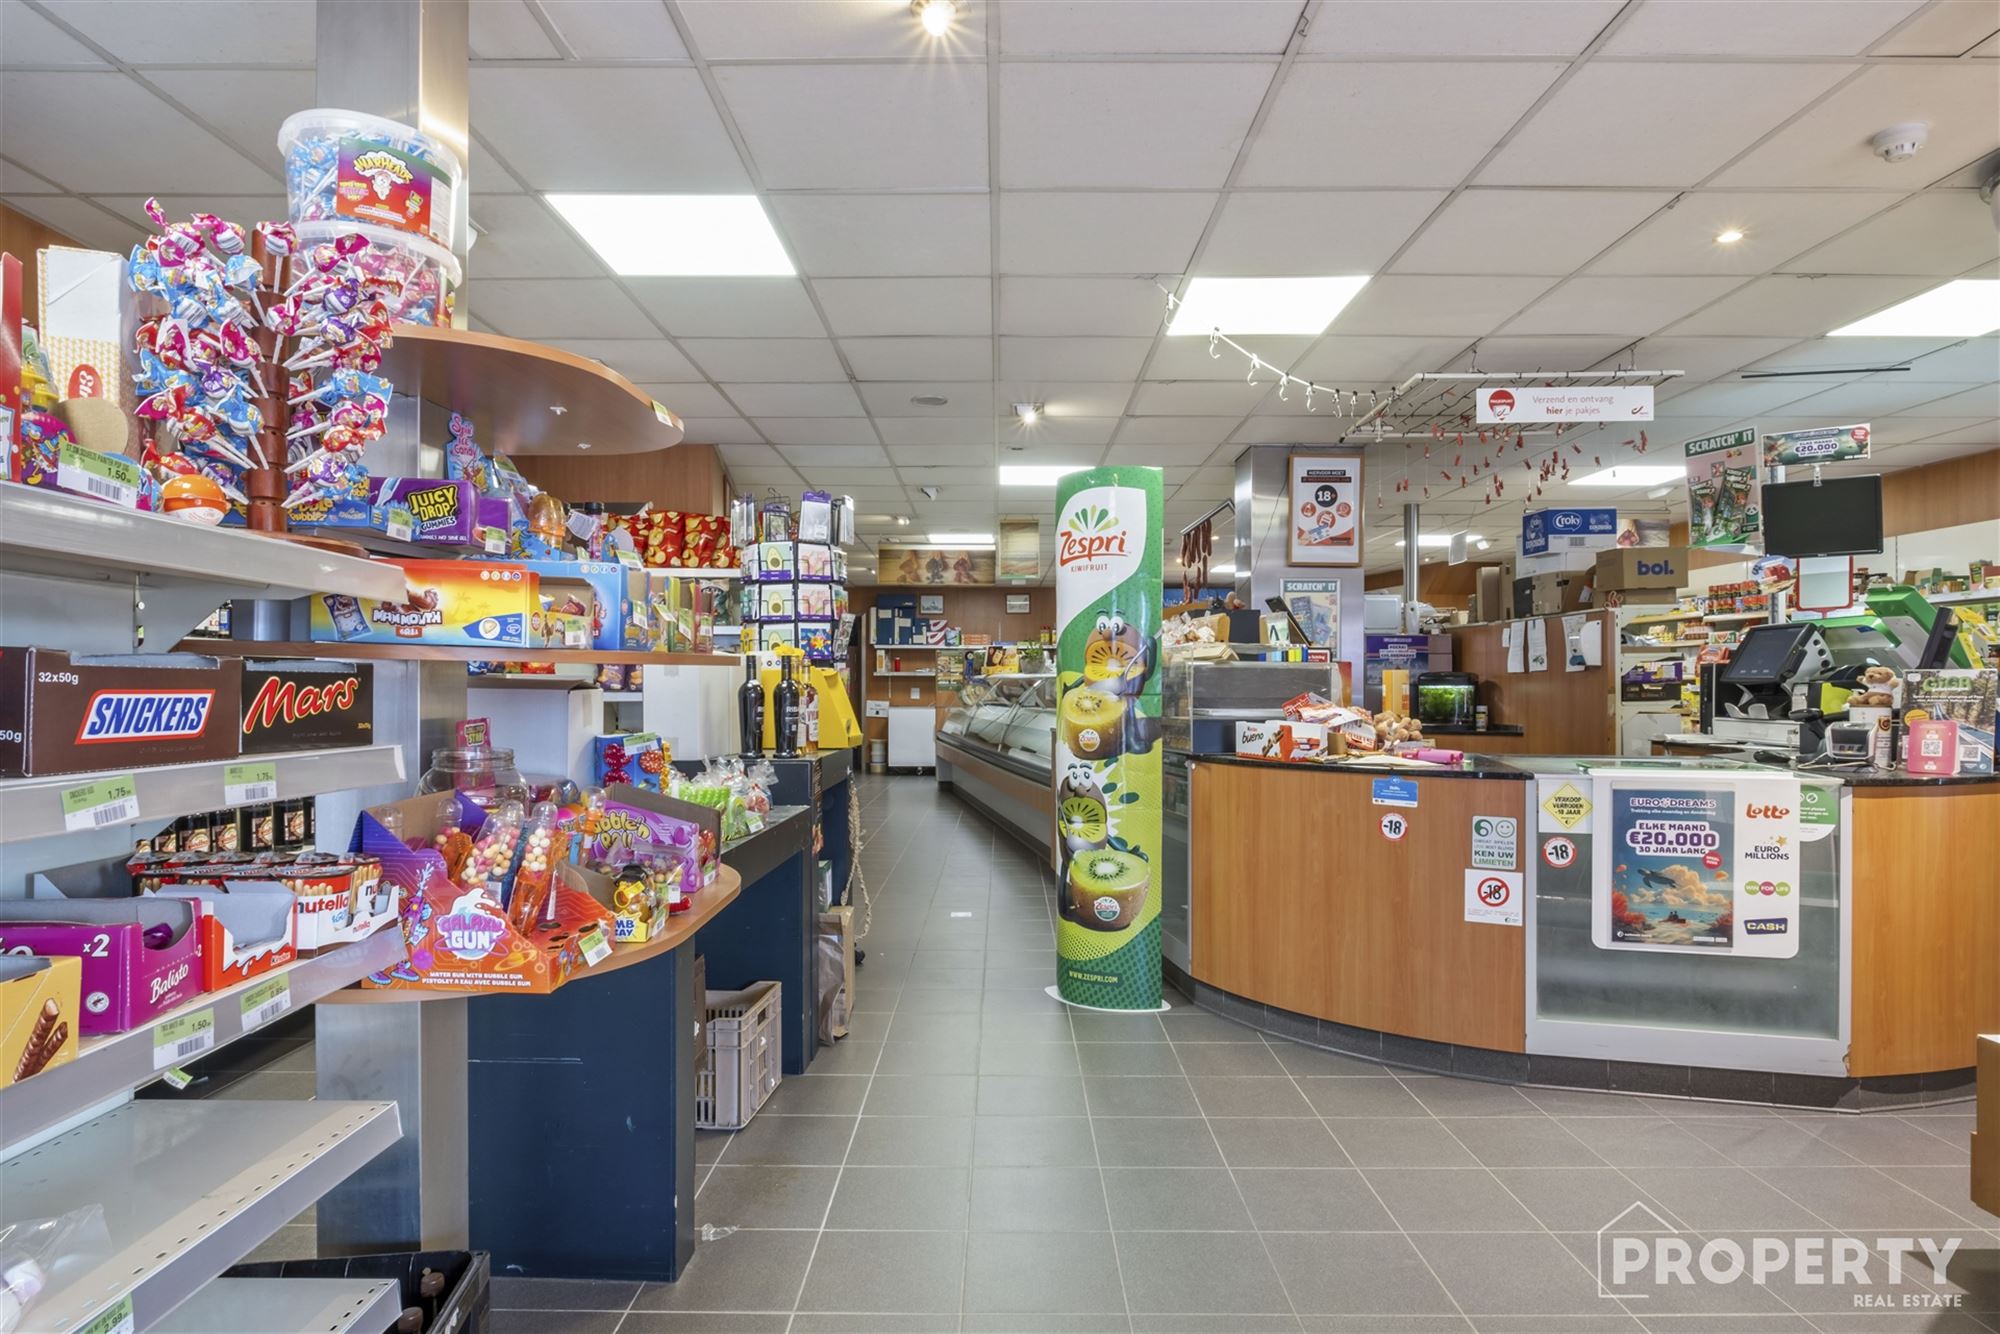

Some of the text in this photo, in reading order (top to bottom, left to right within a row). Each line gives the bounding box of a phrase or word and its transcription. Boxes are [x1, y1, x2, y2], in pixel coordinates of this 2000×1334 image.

[1532, 395, 1565, 404] Verzend
[1581, 395, 1614, 405] ontvang
[1546, 406, 1600, 416] hier je pakjes
[1742, 429, 1754, 442] IT
[1795, 442, 1838, 453] €20.000
[107, 467, 127, 481] 1.50
[410, 486, 455, 514] JUICY
[420, 502, 451, 521] DROP
[420, 516, 456, 531] GUMMIES
[1555, 514, 1581, 528] Croky
[1059, 530, 1129, 567] Zespri
[1071, 563, 1108, 573] KIWIFRUIT
[1637, 559, 1675, 576] bol.
[1287, 582, 1336, 591] SCRATCH' IT
[38, 671, 79, 686] 32x50g
[243, 676, 359, 735] Mars
[87, 696, 208, 736] SNICKERS
[0, 729, 22, 743] 50g
[1242, 731, 1265, 744] bueno
[107, 787, 127, 800] 1.75
[1746, 803, 1790, 819] Lotto
[1383, 819, 1403, 836] -18
[1668, 823, 1707, 832] MAAND
[1629, 831, 1717, 847] €20.000
[1474, 850, 1514, 859] KEN UW
[1548, 844, 1570, 861] -18
[1680, 847, 1706, 855] LANG
[1754, 845, 1781, 853] EURO
[1474, 858, 1514, 867] LIMIETEN
[293, 892, 349, 914] nutella
[438, 913, 503, 932] GALAXY
[1746, 922, 1786, 931] CASH
[83, 933, 110, 957] x2
[450, 930, 491, 950] GUN
[271, 952, 291, 966] Kinder
[150, 963, 189, 1004] Balisto
[1068, 970, 1119, 984] WWW.ZESPRI.COM
[191, 1018, 207, 1033] 1.50
